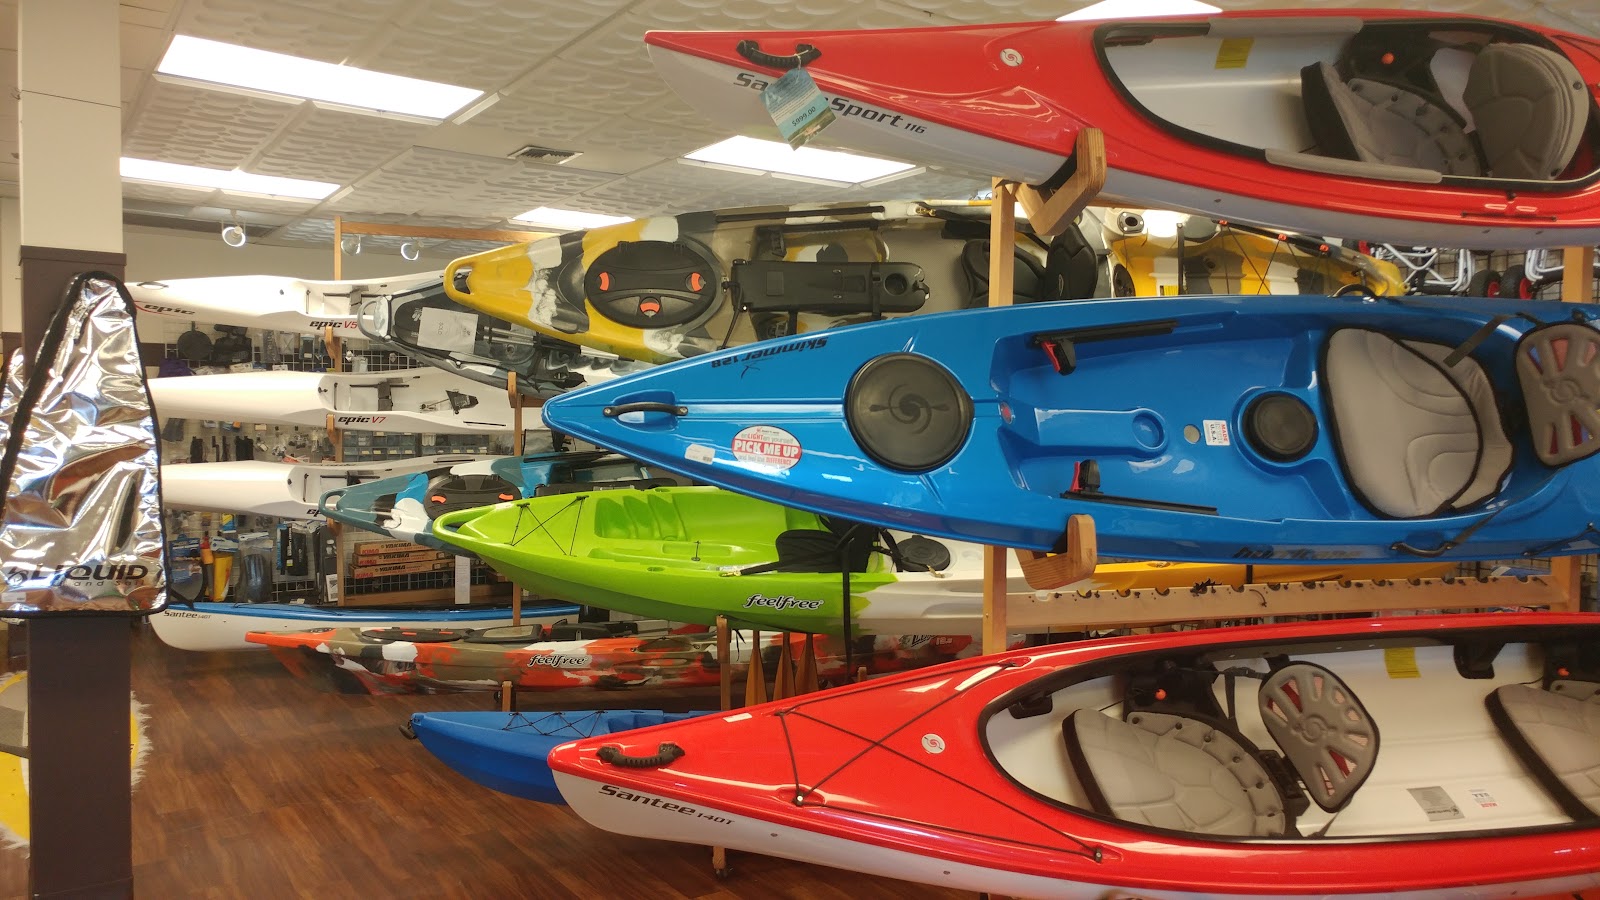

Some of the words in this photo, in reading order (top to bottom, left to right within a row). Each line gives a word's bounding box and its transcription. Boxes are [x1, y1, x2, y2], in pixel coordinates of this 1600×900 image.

[791, 106, 816, 127] $999.00
[830, 97, 903, 128] Sport
[904, 122, 927, 134] 116
[144, 304, 195, 315] epic
[309, 320, 342, 330] epic
[344, 320, 358, 329] V5
[742, 336, 829, 362] Skimmer
[711, 357, 738, 368] 128
[337, 416, 370, 425] epic
[372, 416, 387, 424] V7
[733, 439, 762, 453] PICK
[763, 443, 781, 455] ME
[782, 445, 799, 457] UP
[743, 594, 820, 610] feelfree
[163, 610, 198, 619] Santee
[527, 654, 587, 668] feelfree
[598, 784, 696, 816] Santee
[697, 812, 735, 826] 140T
